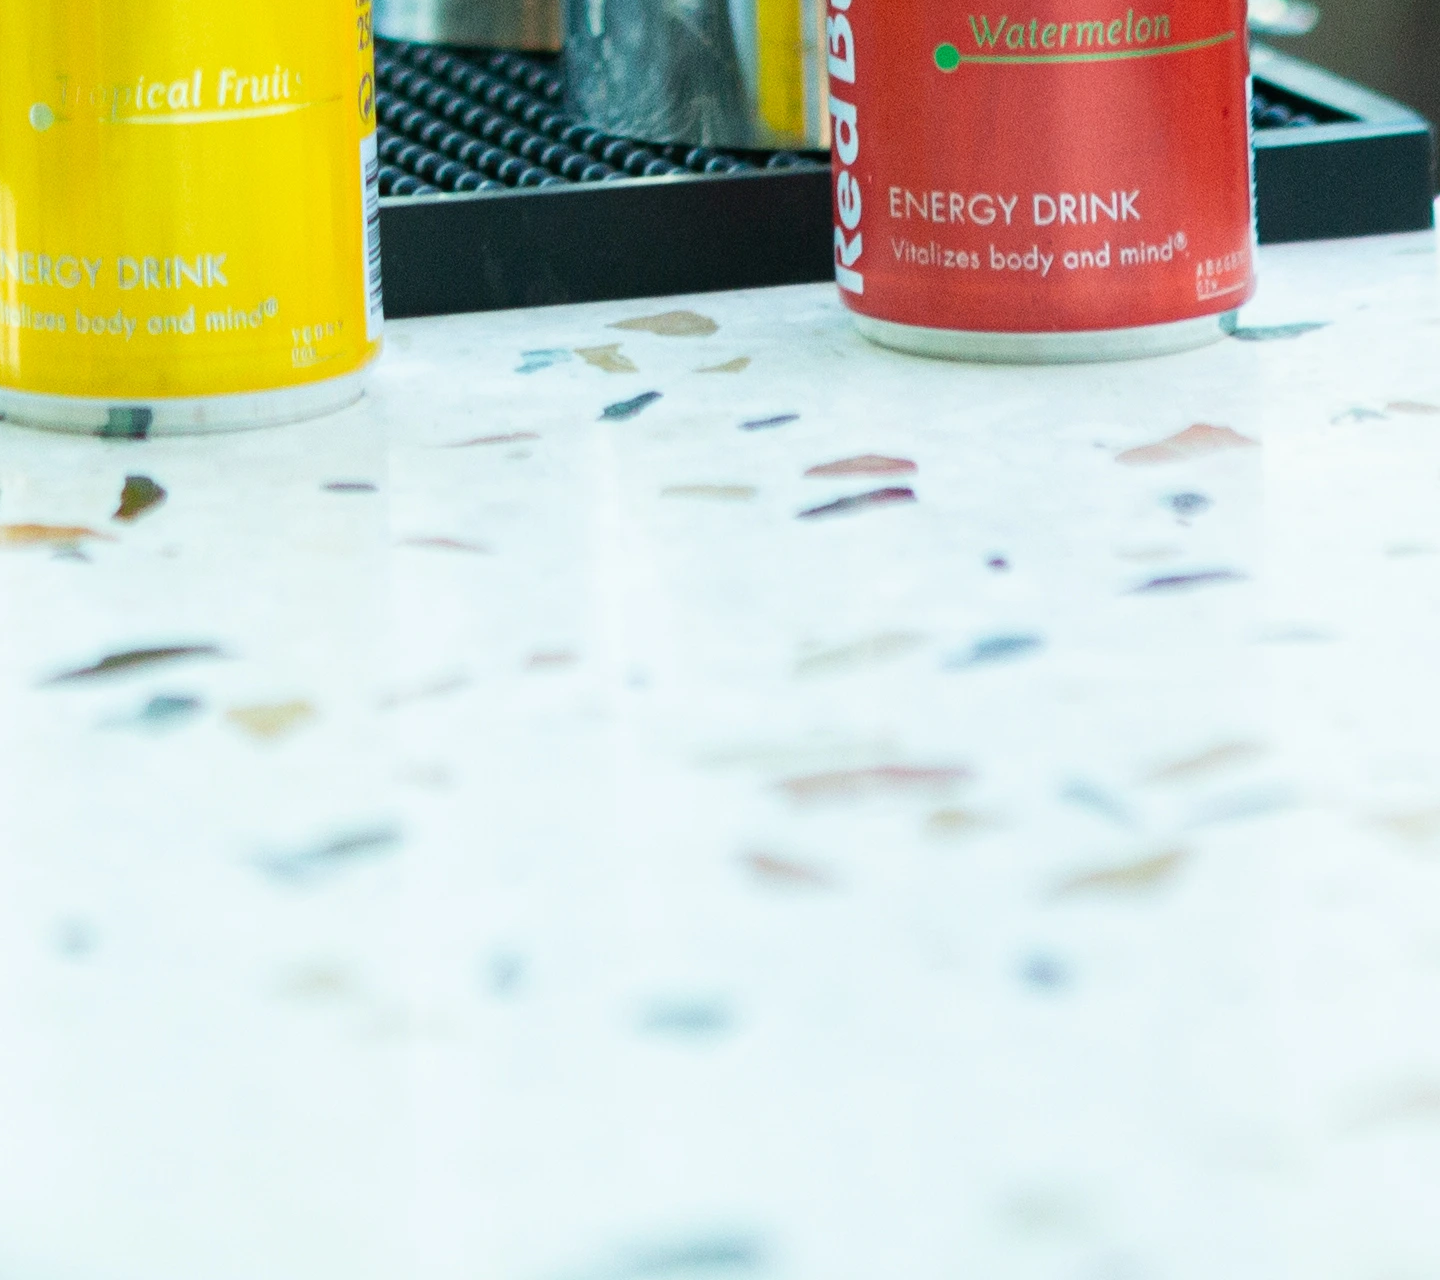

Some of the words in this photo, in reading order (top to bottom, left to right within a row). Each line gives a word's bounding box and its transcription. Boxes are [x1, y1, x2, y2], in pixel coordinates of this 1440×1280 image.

[969, 8, 1170, 48] Watermelon
[828, 94, 864, 294] Red
[888, 186, 1018, 225] ENERGY
[1032, 189, 1141, 225] DRINK
[116, 252, 228, 290] DRINK
[890, 237, 980, 269] Vitalizes
[989, 244, 1054, 277] body
[1063, 241, 1111, 270] and
[76, 306, 137, 342] body
[146, 303, 195, 335] and
